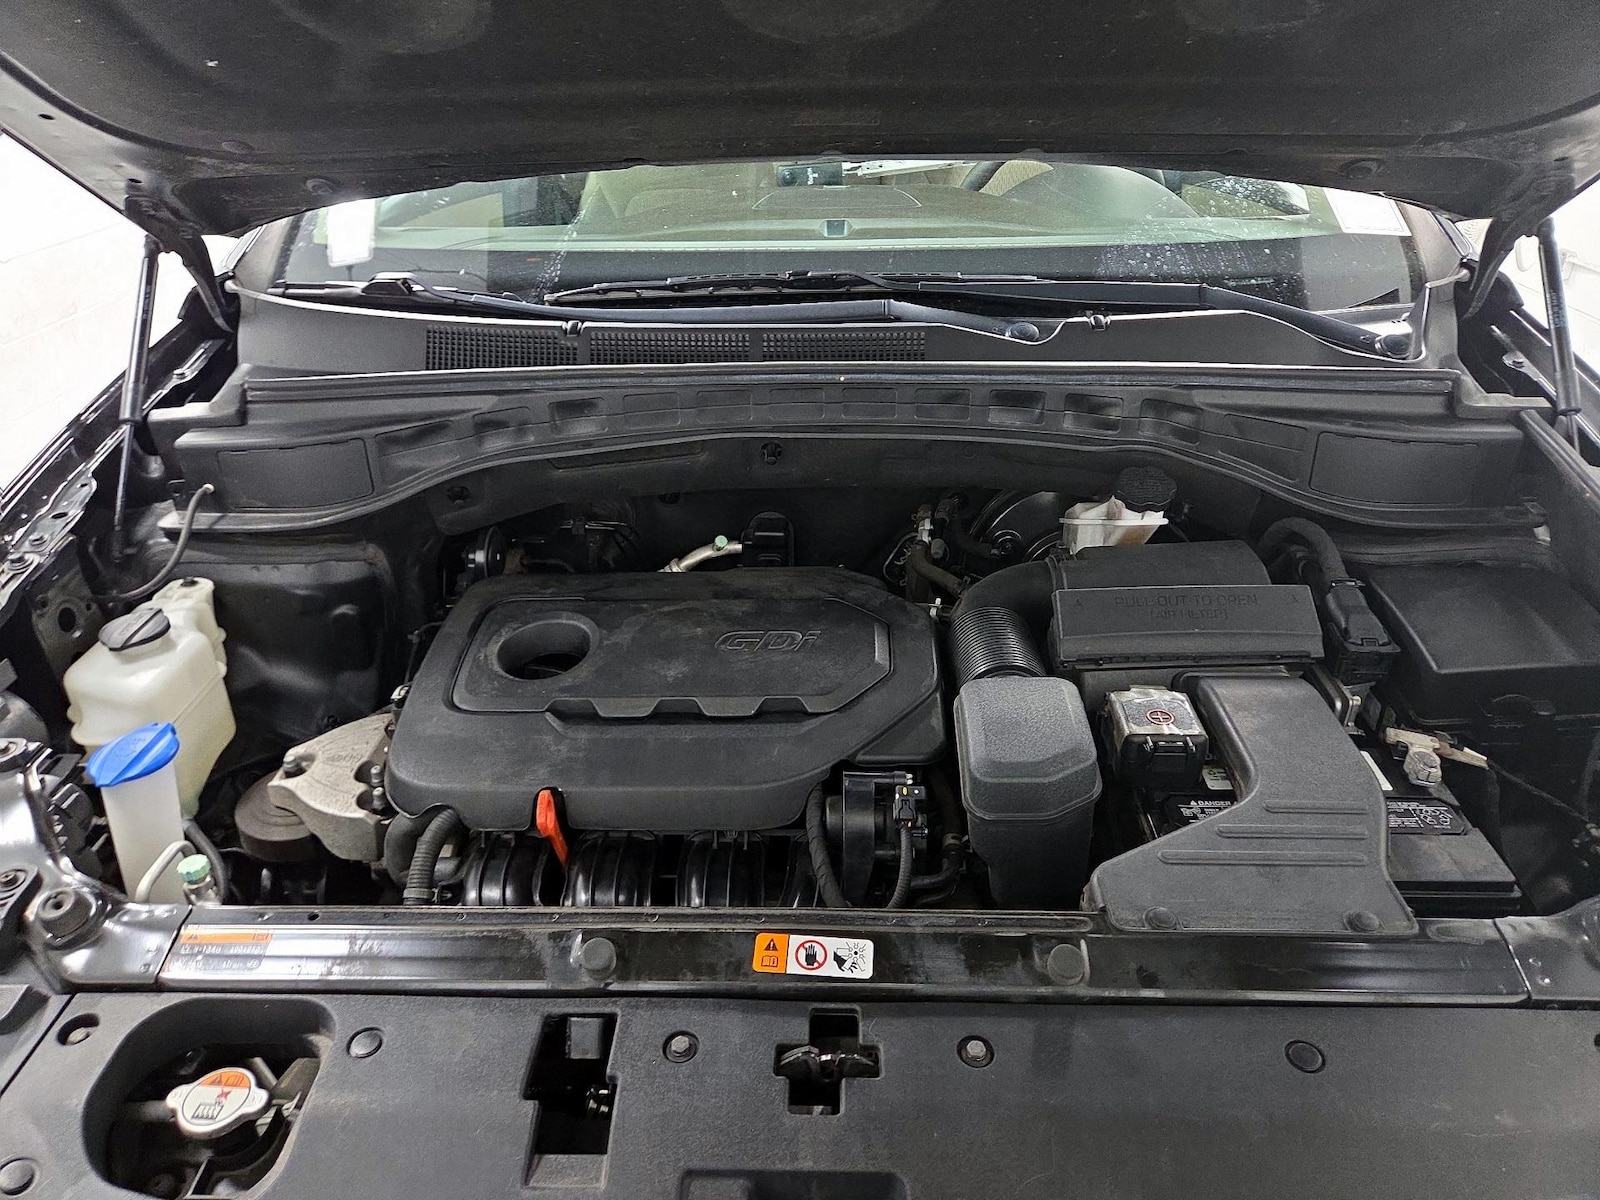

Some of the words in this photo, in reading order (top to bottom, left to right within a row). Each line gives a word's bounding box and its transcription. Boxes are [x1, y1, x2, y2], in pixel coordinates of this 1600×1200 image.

[1114, 596, 1154, 607] PULL
[1156, 595, 1187, 607] OUT
[1194, 595, 1212, 606] TO
[1216, 594, 1259, 606] OPEN
